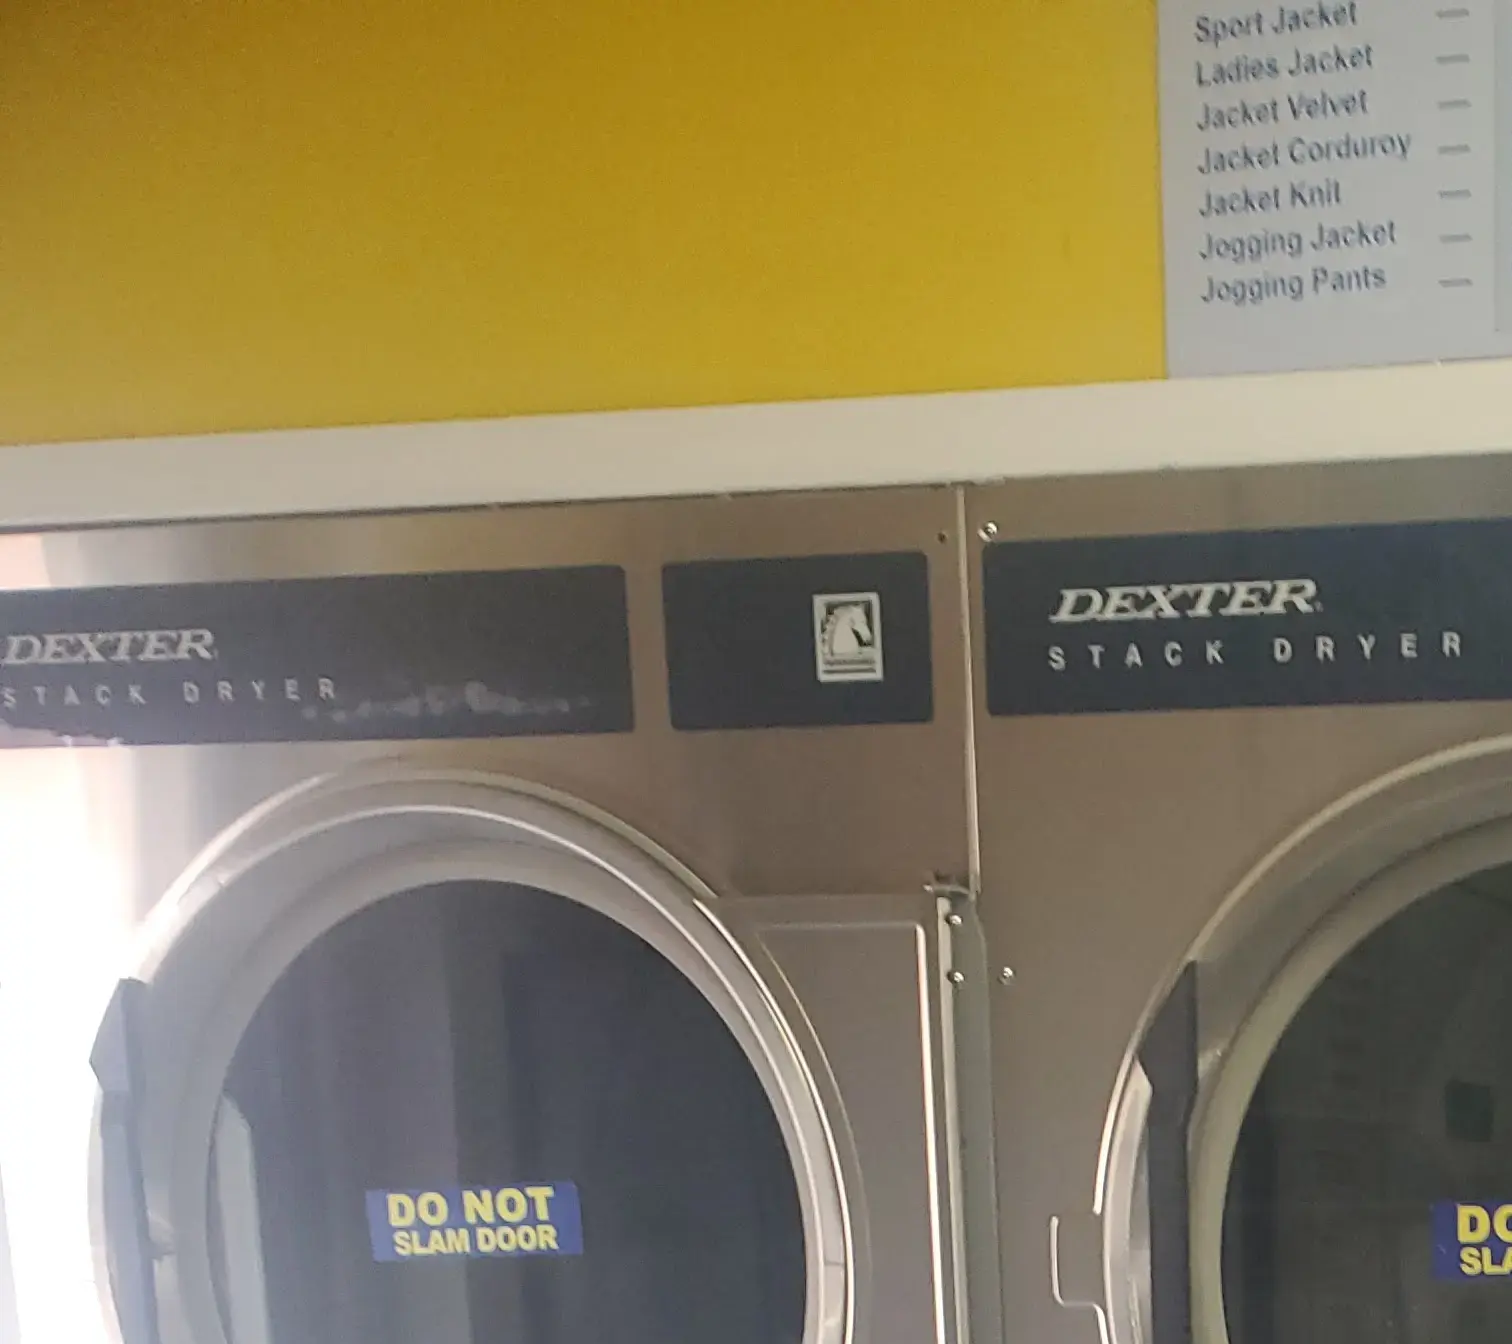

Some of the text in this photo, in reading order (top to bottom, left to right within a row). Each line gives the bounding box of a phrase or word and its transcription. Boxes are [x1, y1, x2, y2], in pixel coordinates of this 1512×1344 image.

[1195, 0, 1358, 46] Sport Jacket
[1196, 43, 1374, 88] Ladies Jacket
[1197, 88, 1369, 132] Jacket Velvet
[1197, 132, 1413, 175] Jacket Corduroy
[1198, 178, 1342, 218] Jacket Knit
[1198, 219, 1397, 264] Jogging Jacket
[1200, 265, 1387, 307] Jogging Pants
[1048, 578, 1321, 624] DEXTER
[0, 628, 218, 665] DEXTER
[1048, 631, 1464, 672] STACK DRYER
[0, 676, 337, 709] STACK DRYER
[386, 1186, 555, 1227] DO NOT
[392, 1224, 560, 1256] SLAM DOOR
